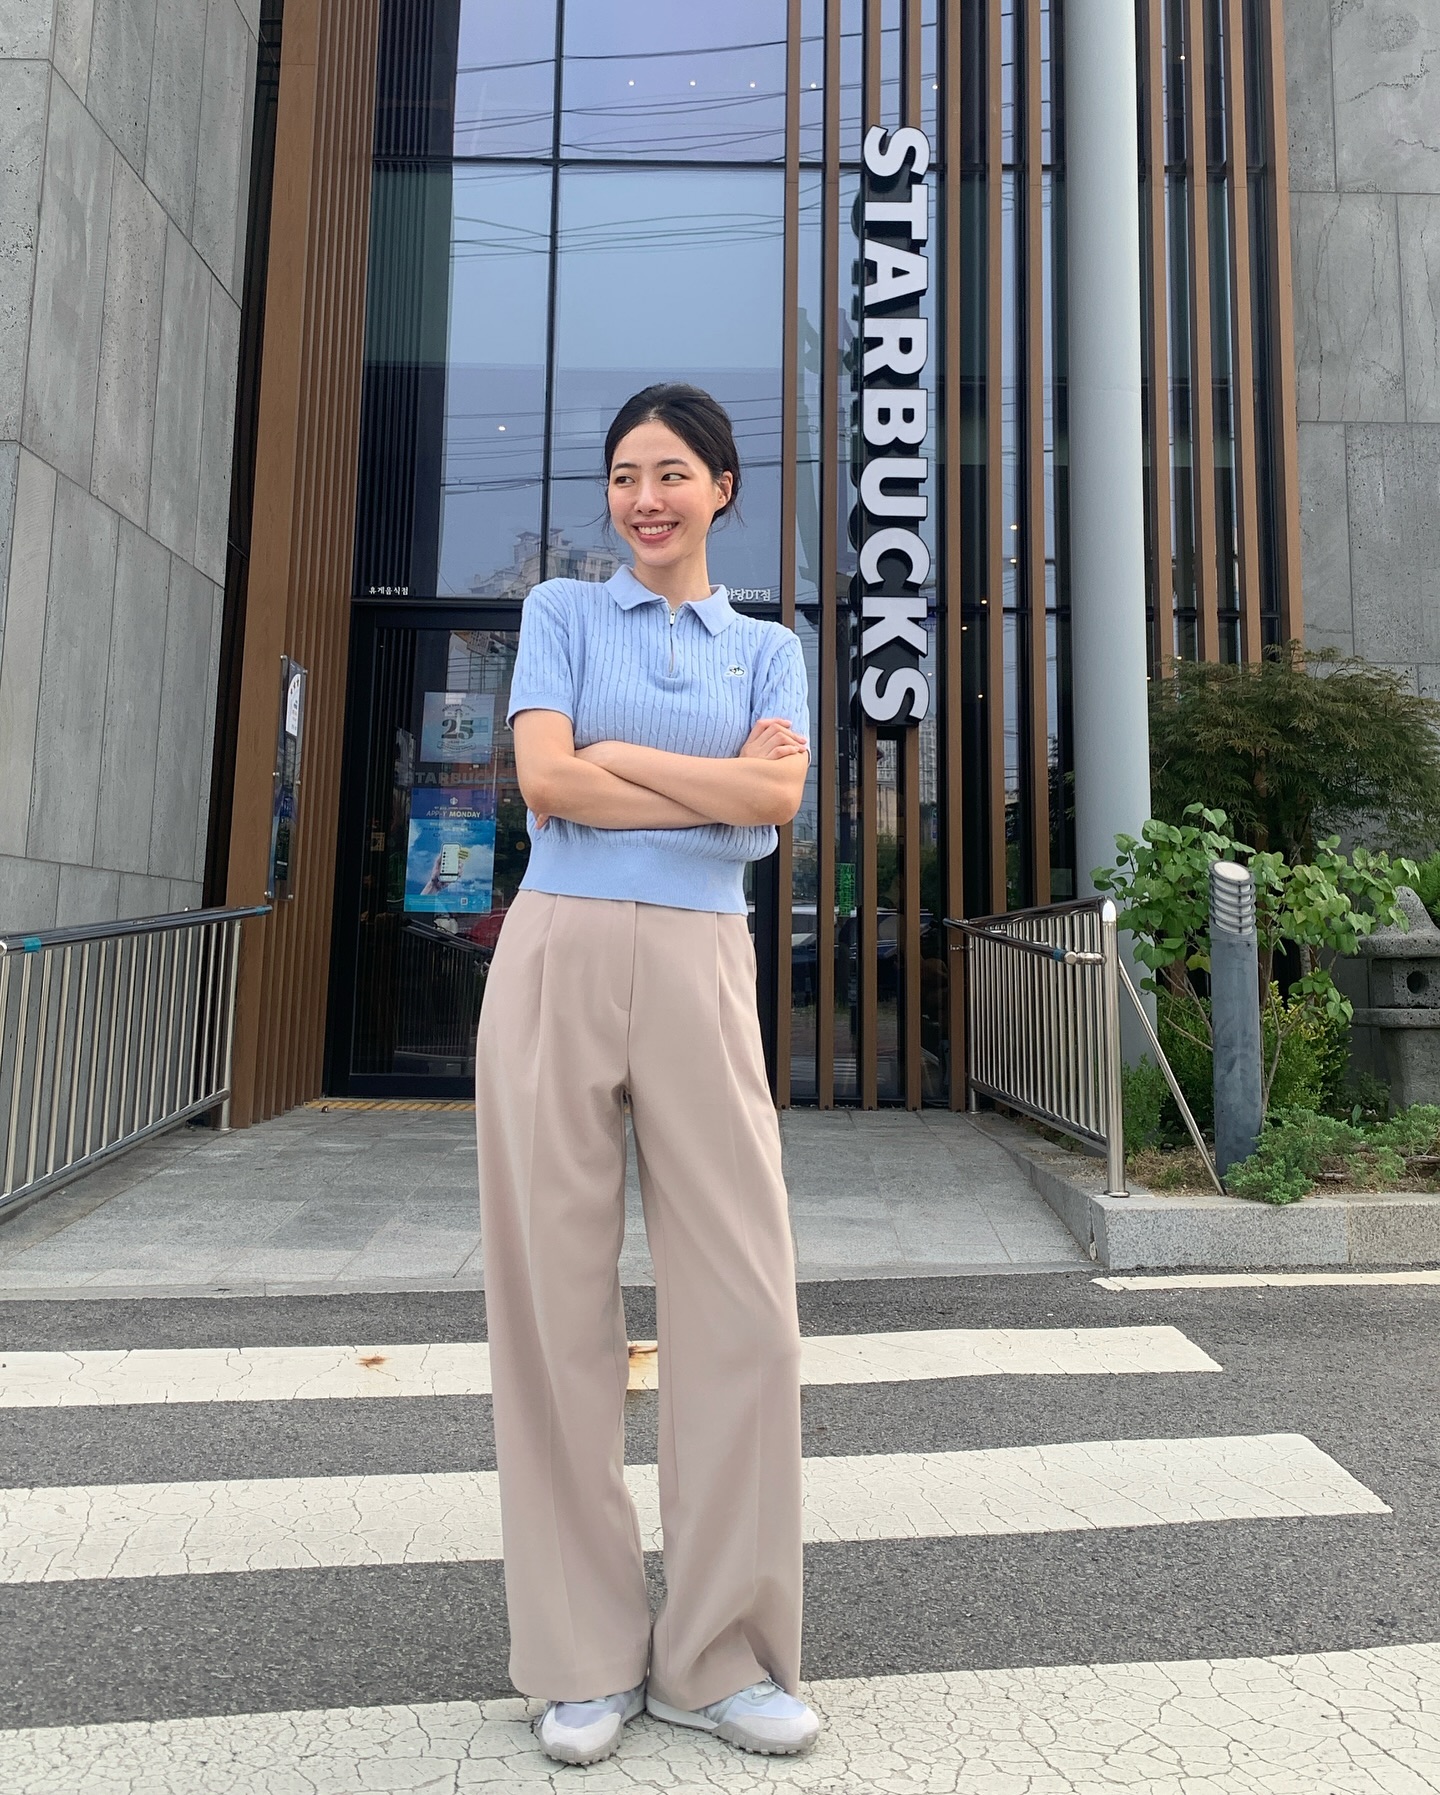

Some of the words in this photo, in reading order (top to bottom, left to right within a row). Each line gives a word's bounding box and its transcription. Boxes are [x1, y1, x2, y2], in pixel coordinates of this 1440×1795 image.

[860, 125, 930, 725] STARBUCKS
[368, 586, 409, 596] 휴게음식점
[441, 718, 474, 740] 25
